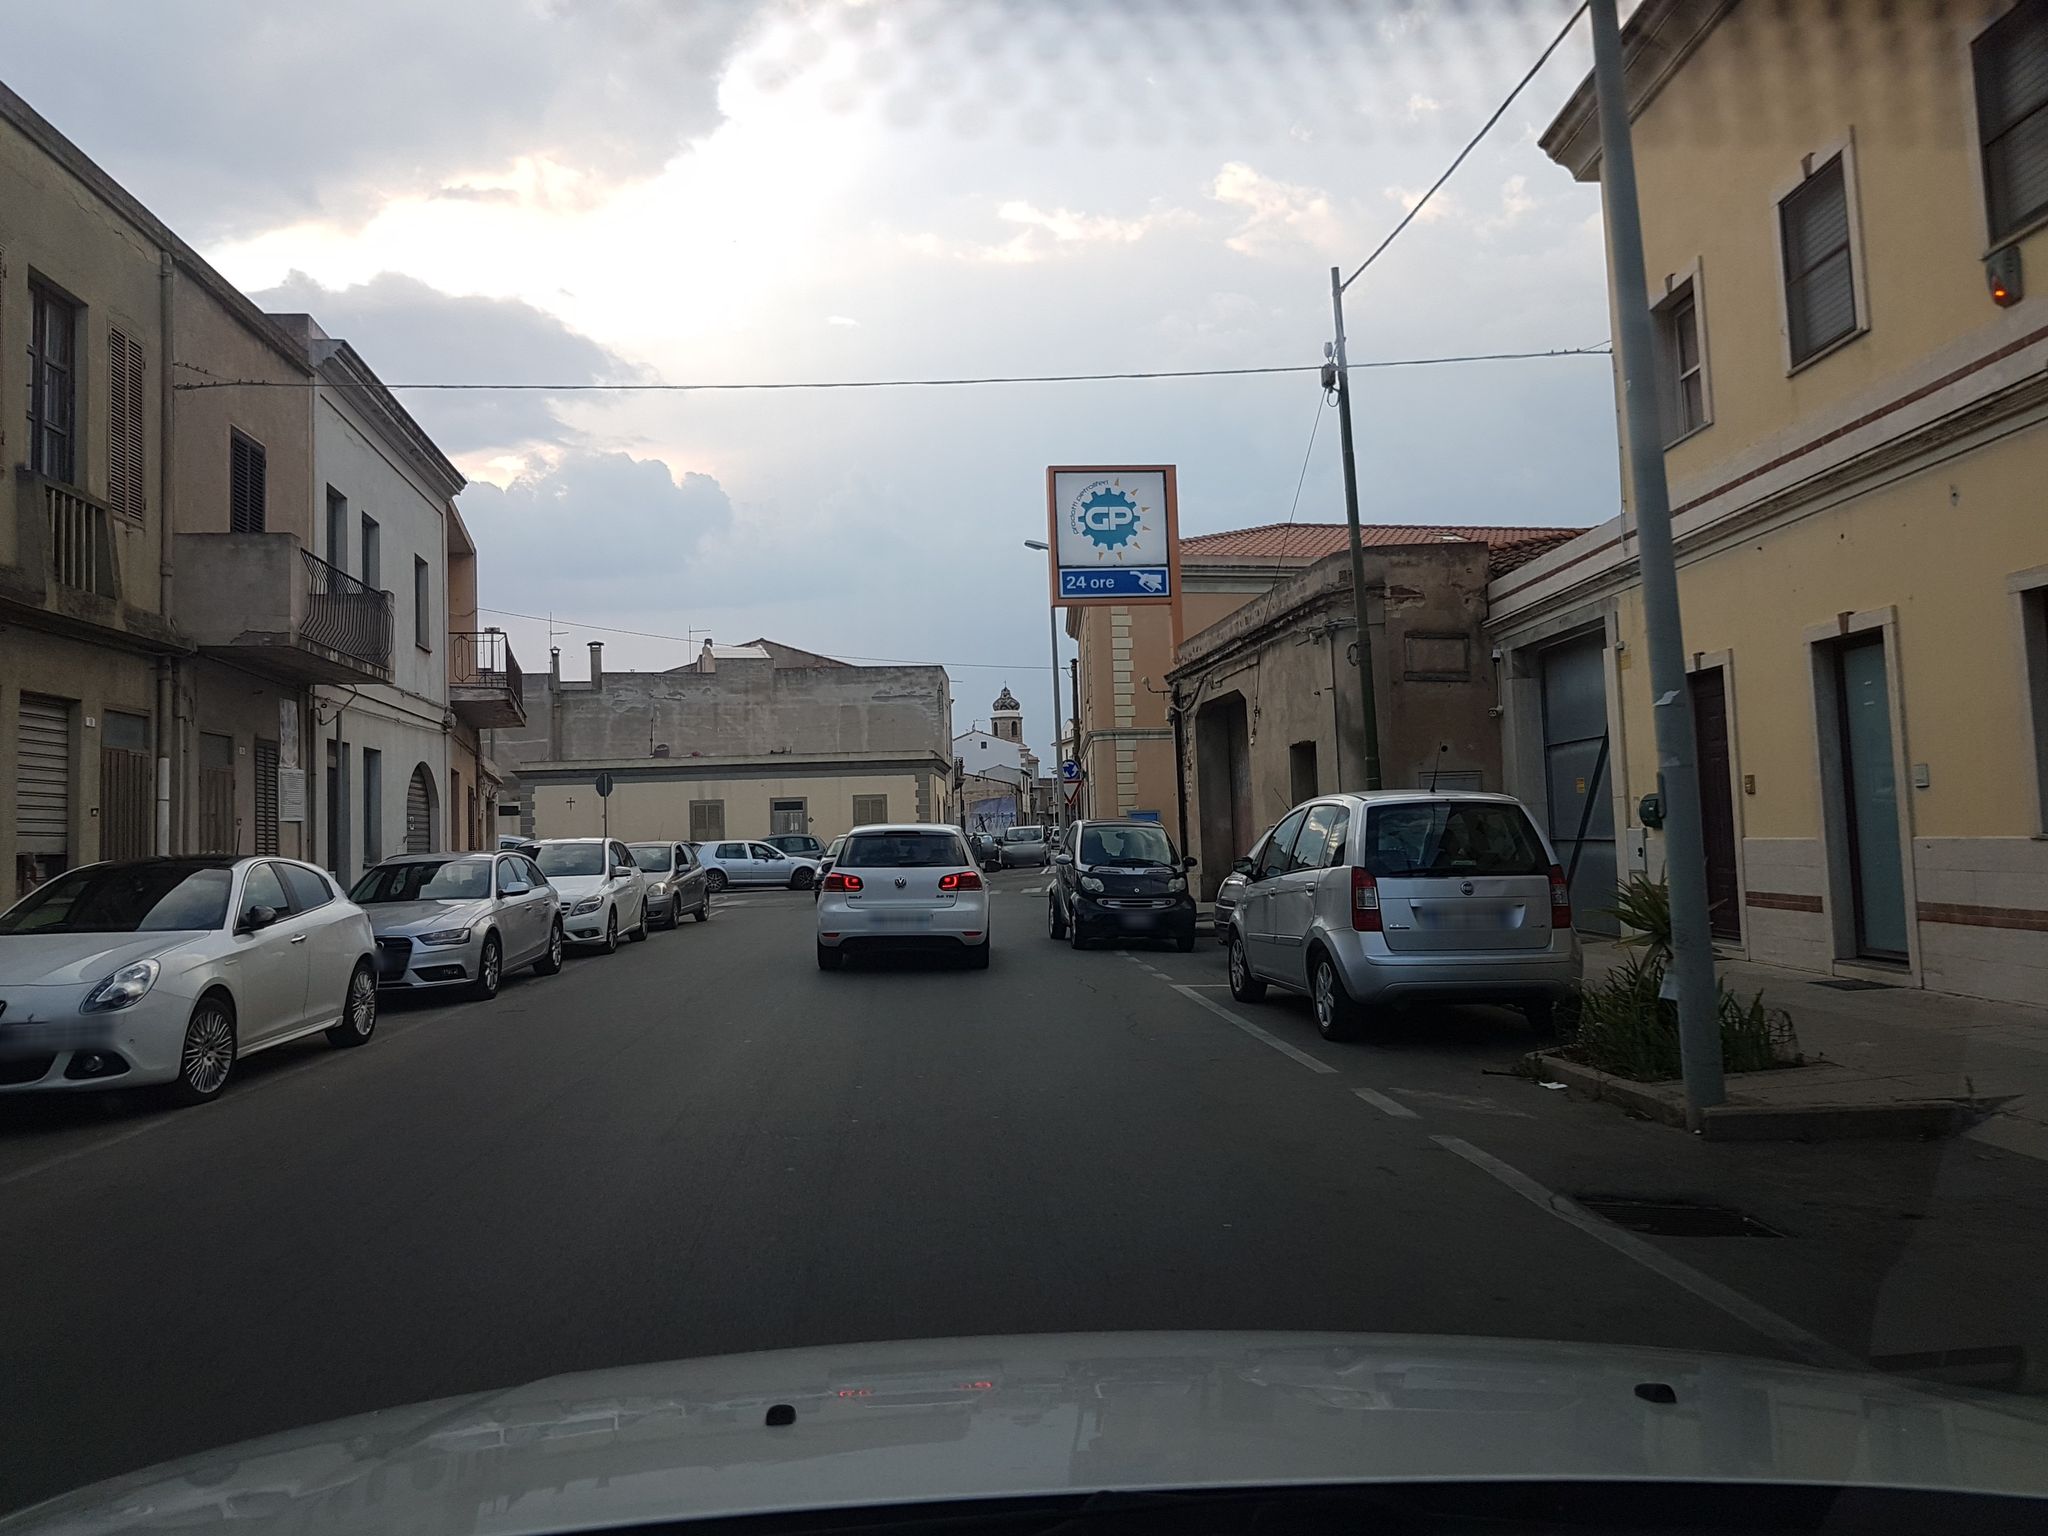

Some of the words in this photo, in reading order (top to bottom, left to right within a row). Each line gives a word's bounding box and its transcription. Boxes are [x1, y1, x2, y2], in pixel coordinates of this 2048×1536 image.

[1085, 506, 1133, 531] GP
[1066, 576, 1087, 589] 24
[1090, 577, 1115, 589] ore
